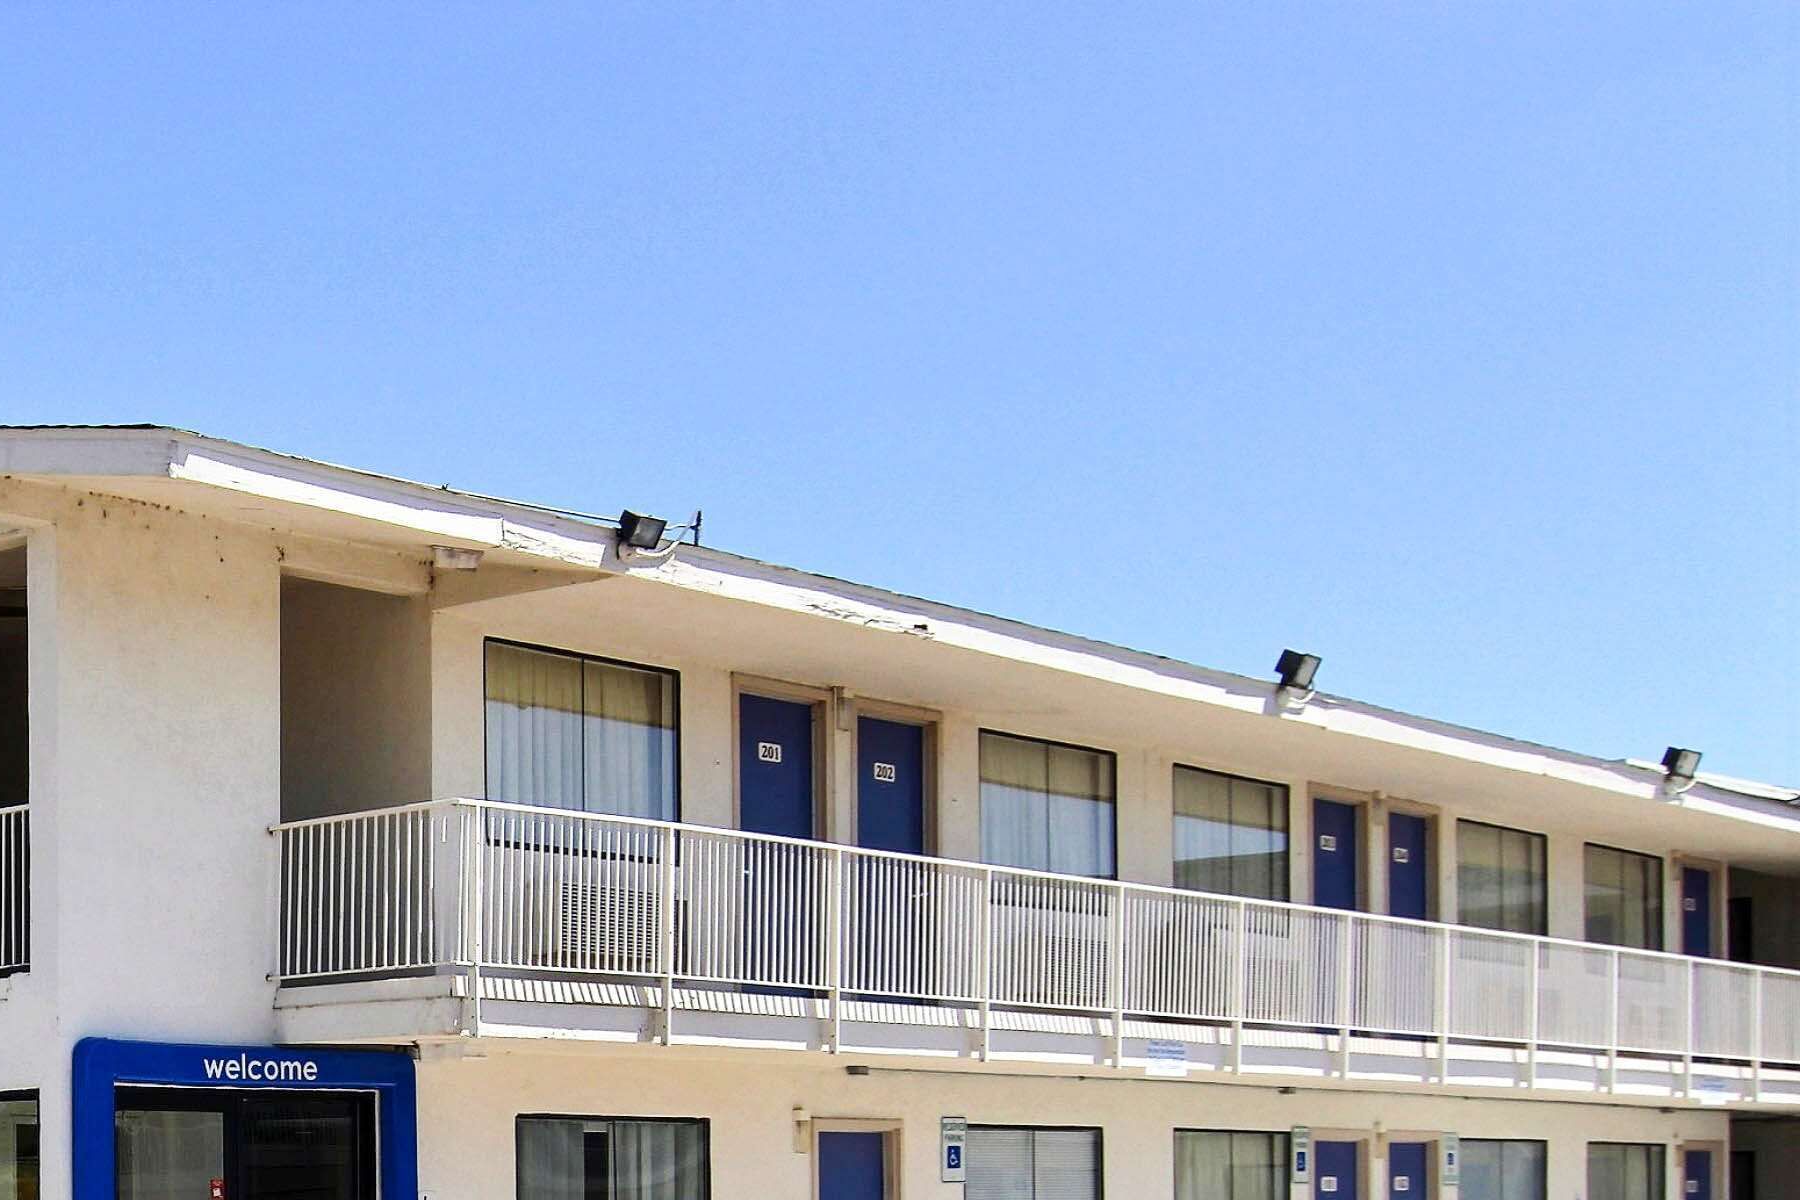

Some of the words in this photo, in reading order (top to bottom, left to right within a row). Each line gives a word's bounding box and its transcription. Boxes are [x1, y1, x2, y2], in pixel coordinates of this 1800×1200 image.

[761, 745, 779, 760] 201
[876, 765, 893, 780] 202
[203, 1053, 318, 1081] welcome
